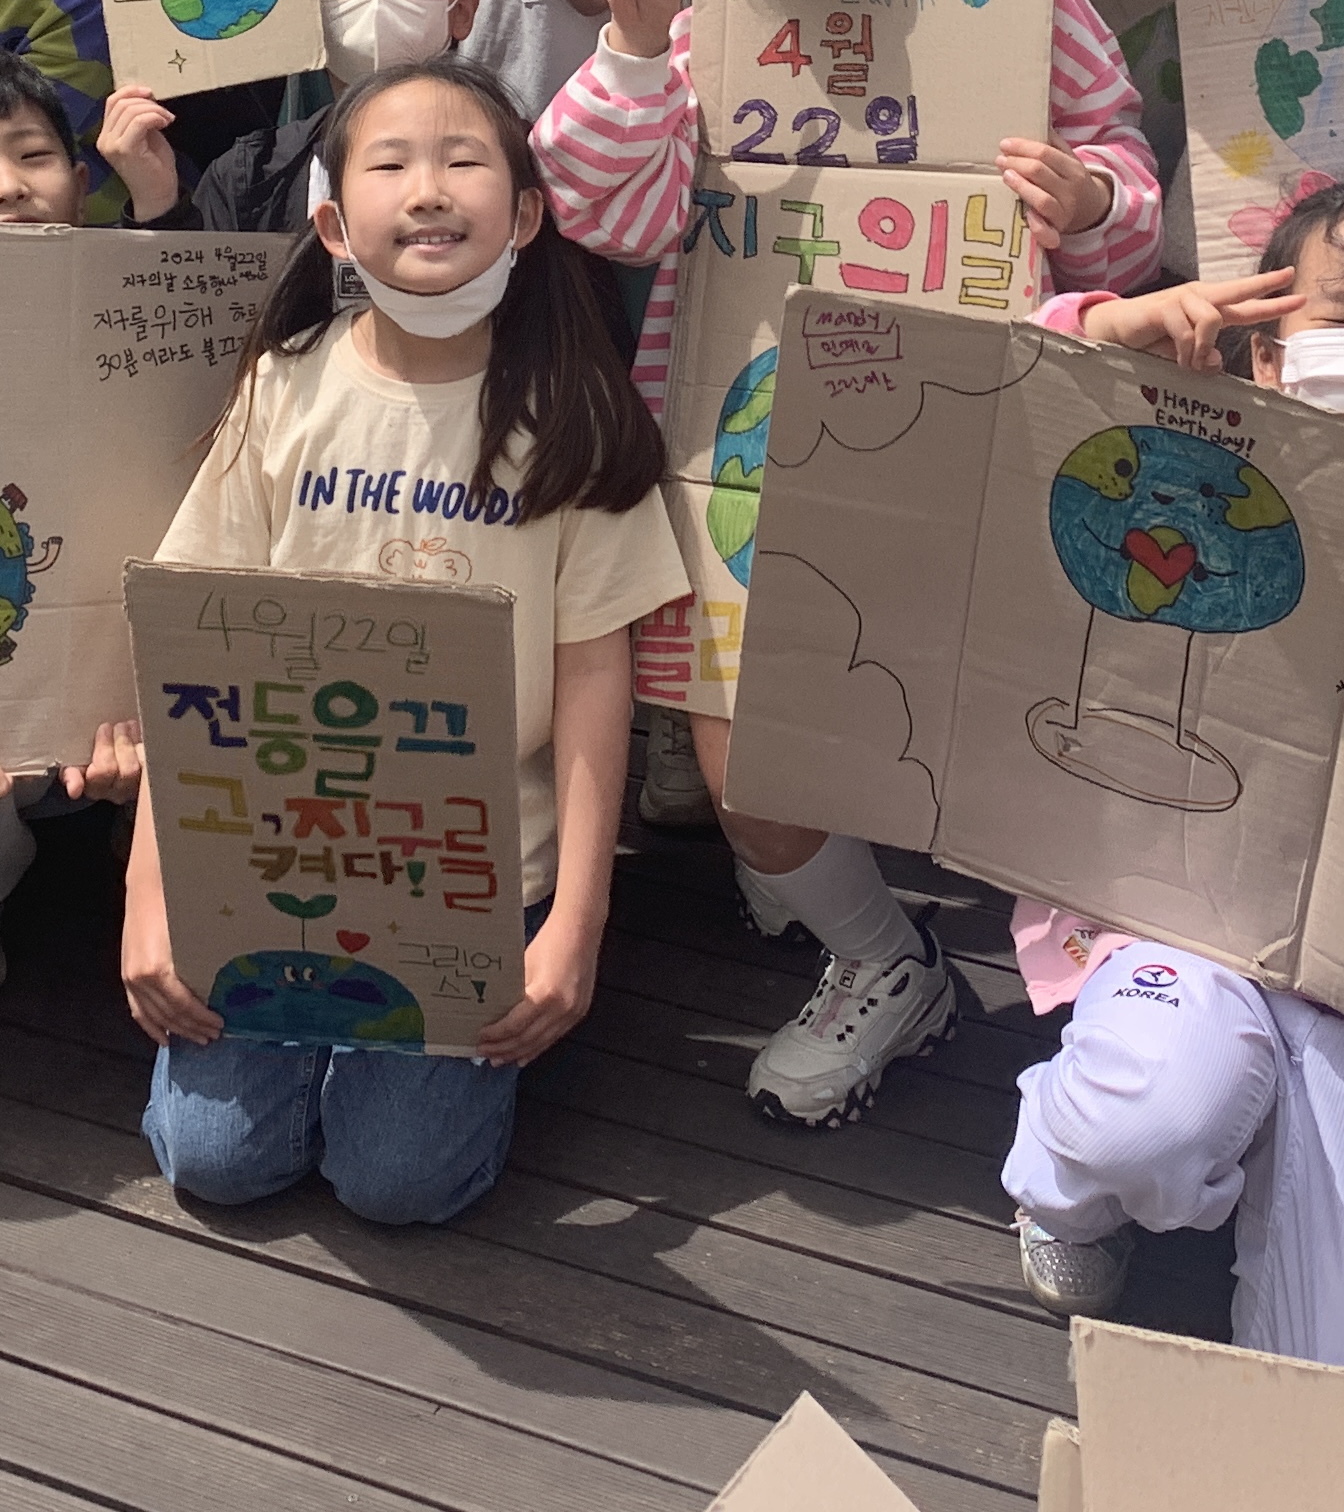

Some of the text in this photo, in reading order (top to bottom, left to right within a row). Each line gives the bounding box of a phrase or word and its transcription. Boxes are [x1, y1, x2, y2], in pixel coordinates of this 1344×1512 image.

[758, 11, 874, 97] 4월
[731, 95, 920, 168] 22일
[161, 251, 204, 264] 2024
[816, 307, 880, 330] Mandy
[1164, 389, 1224, 420] Happy
[299, 467, 521, 526] IN THE WOODS
[1112, 988, 1180, 1008] KOREA
